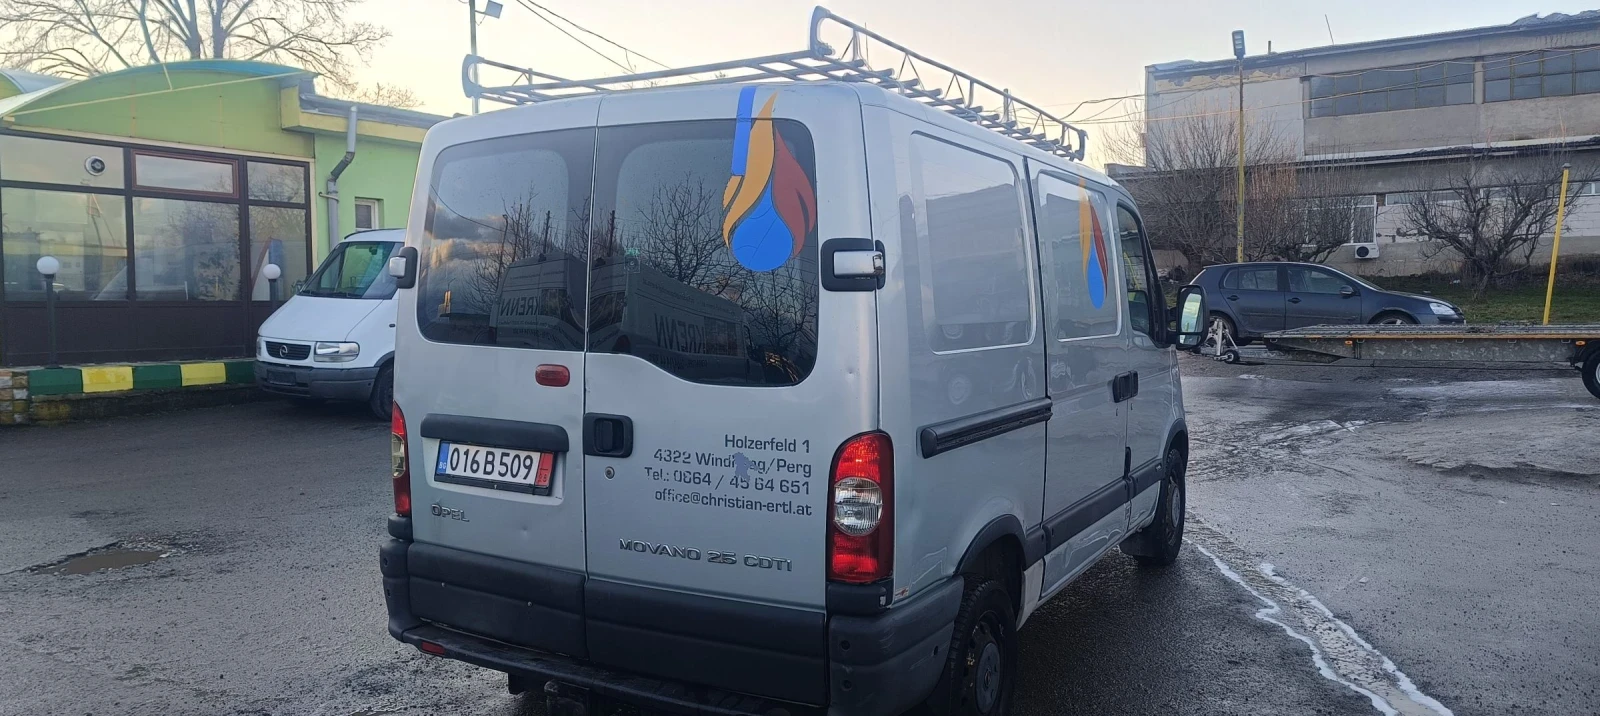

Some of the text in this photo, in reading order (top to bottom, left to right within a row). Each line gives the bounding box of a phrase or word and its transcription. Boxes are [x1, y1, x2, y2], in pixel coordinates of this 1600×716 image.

[724, 434, 811, 454] Holzerfeld 1
[654, 449, 811, 477] 4322 Windag/Perg
[644, 466, 670, 481] Tel.:
[779, 480, 811, 495] 651
[431, 504, 470, 522] OPEL
[655, 489, 812, 516] office@christian-ertl.at
[619, 538, 701, 560] MOVANO
